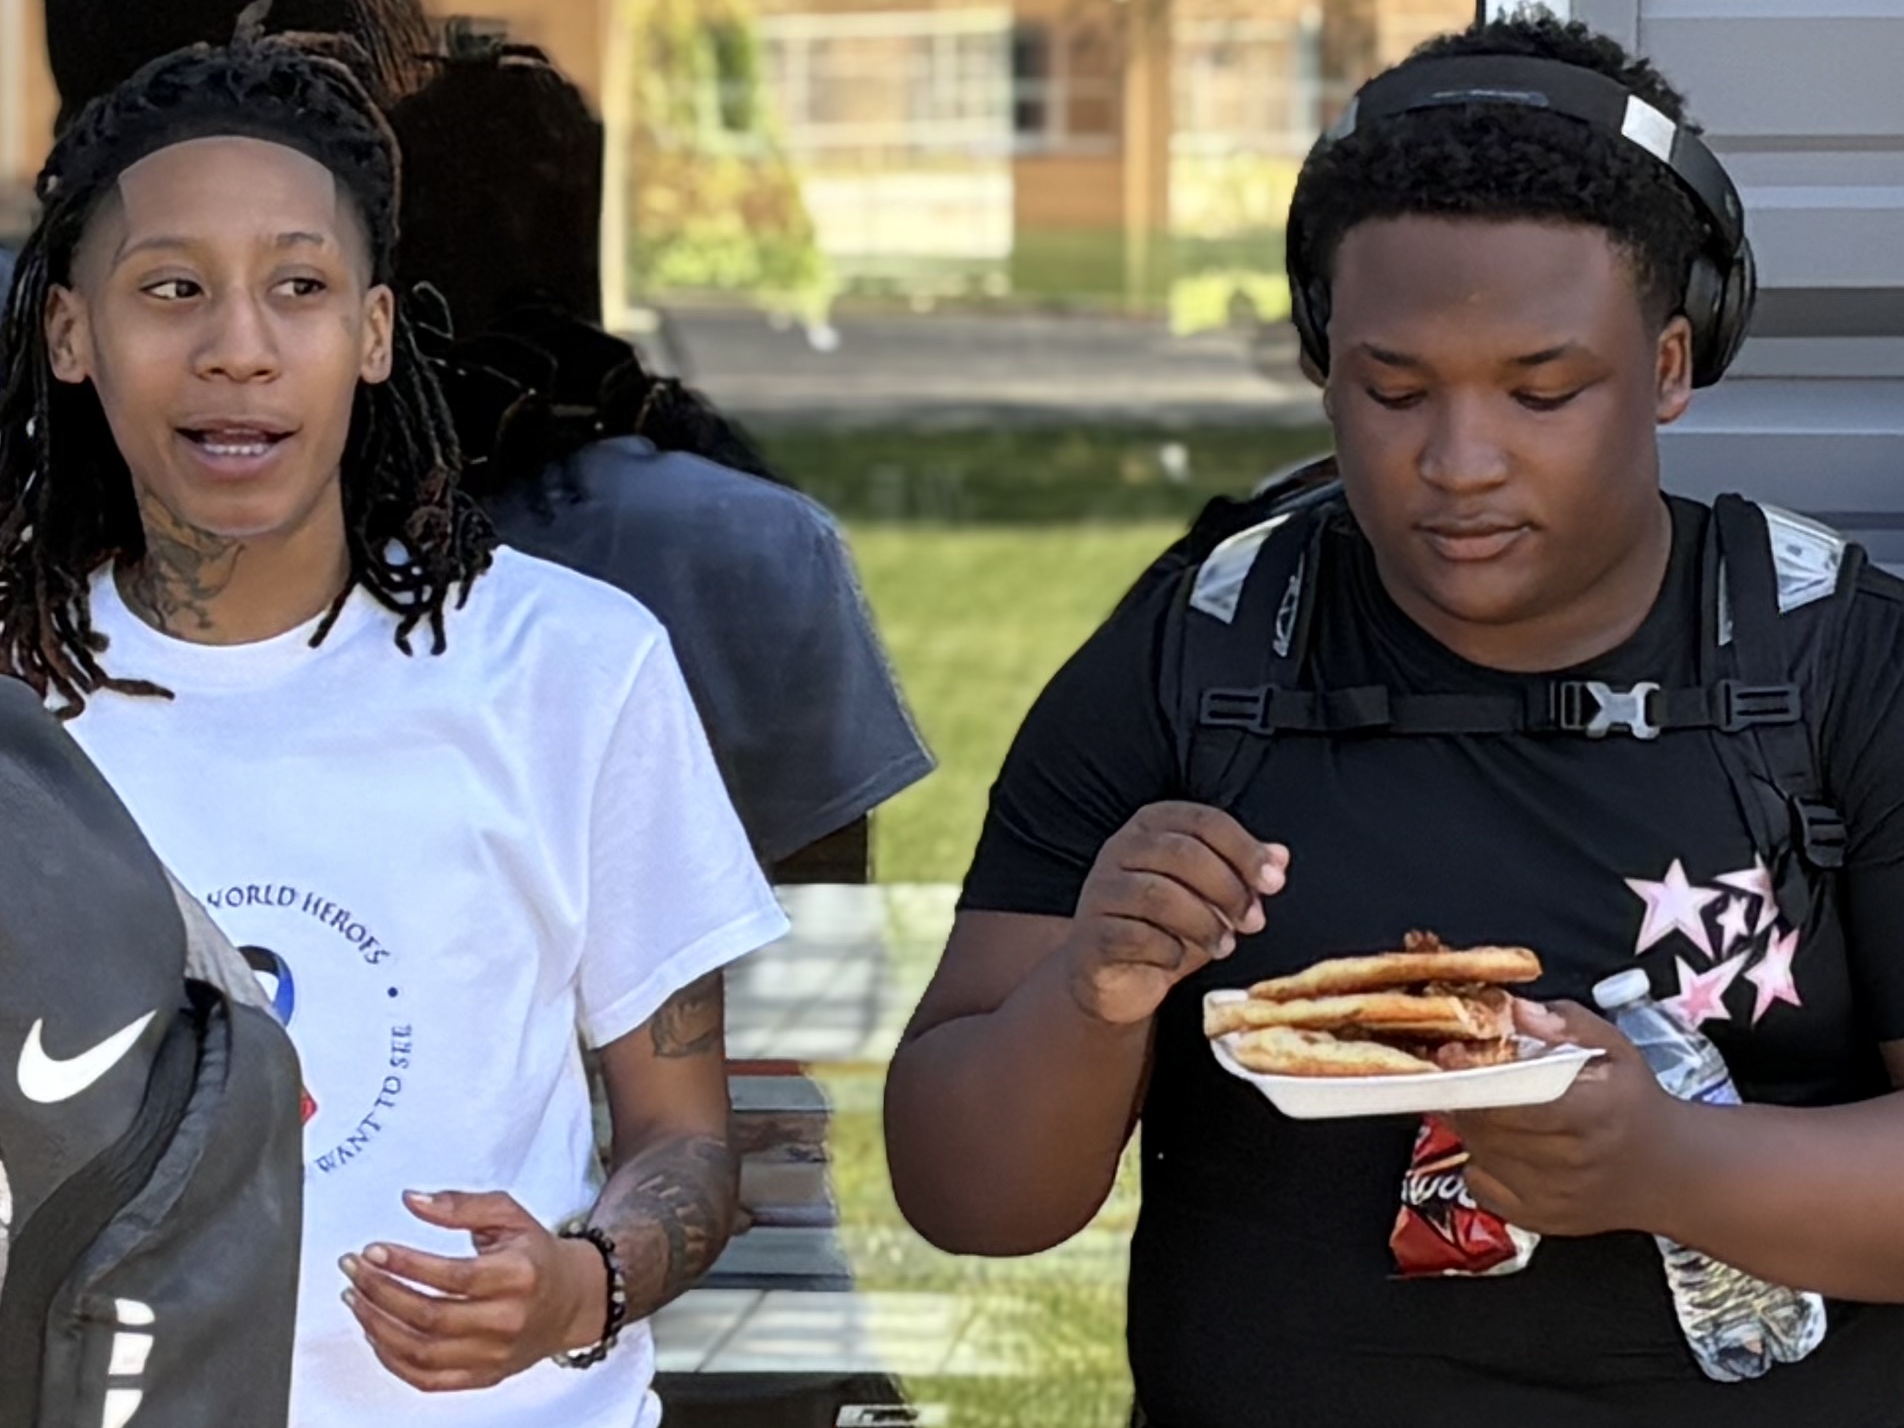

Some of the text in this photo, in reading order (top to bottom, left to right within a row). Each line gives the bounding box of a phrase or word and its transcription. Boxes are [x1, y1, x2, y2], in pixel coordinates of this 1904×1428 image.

[302, 892, 391, 964] HEROES
[315, 1024, 413, 1172] WANT TO SEE
